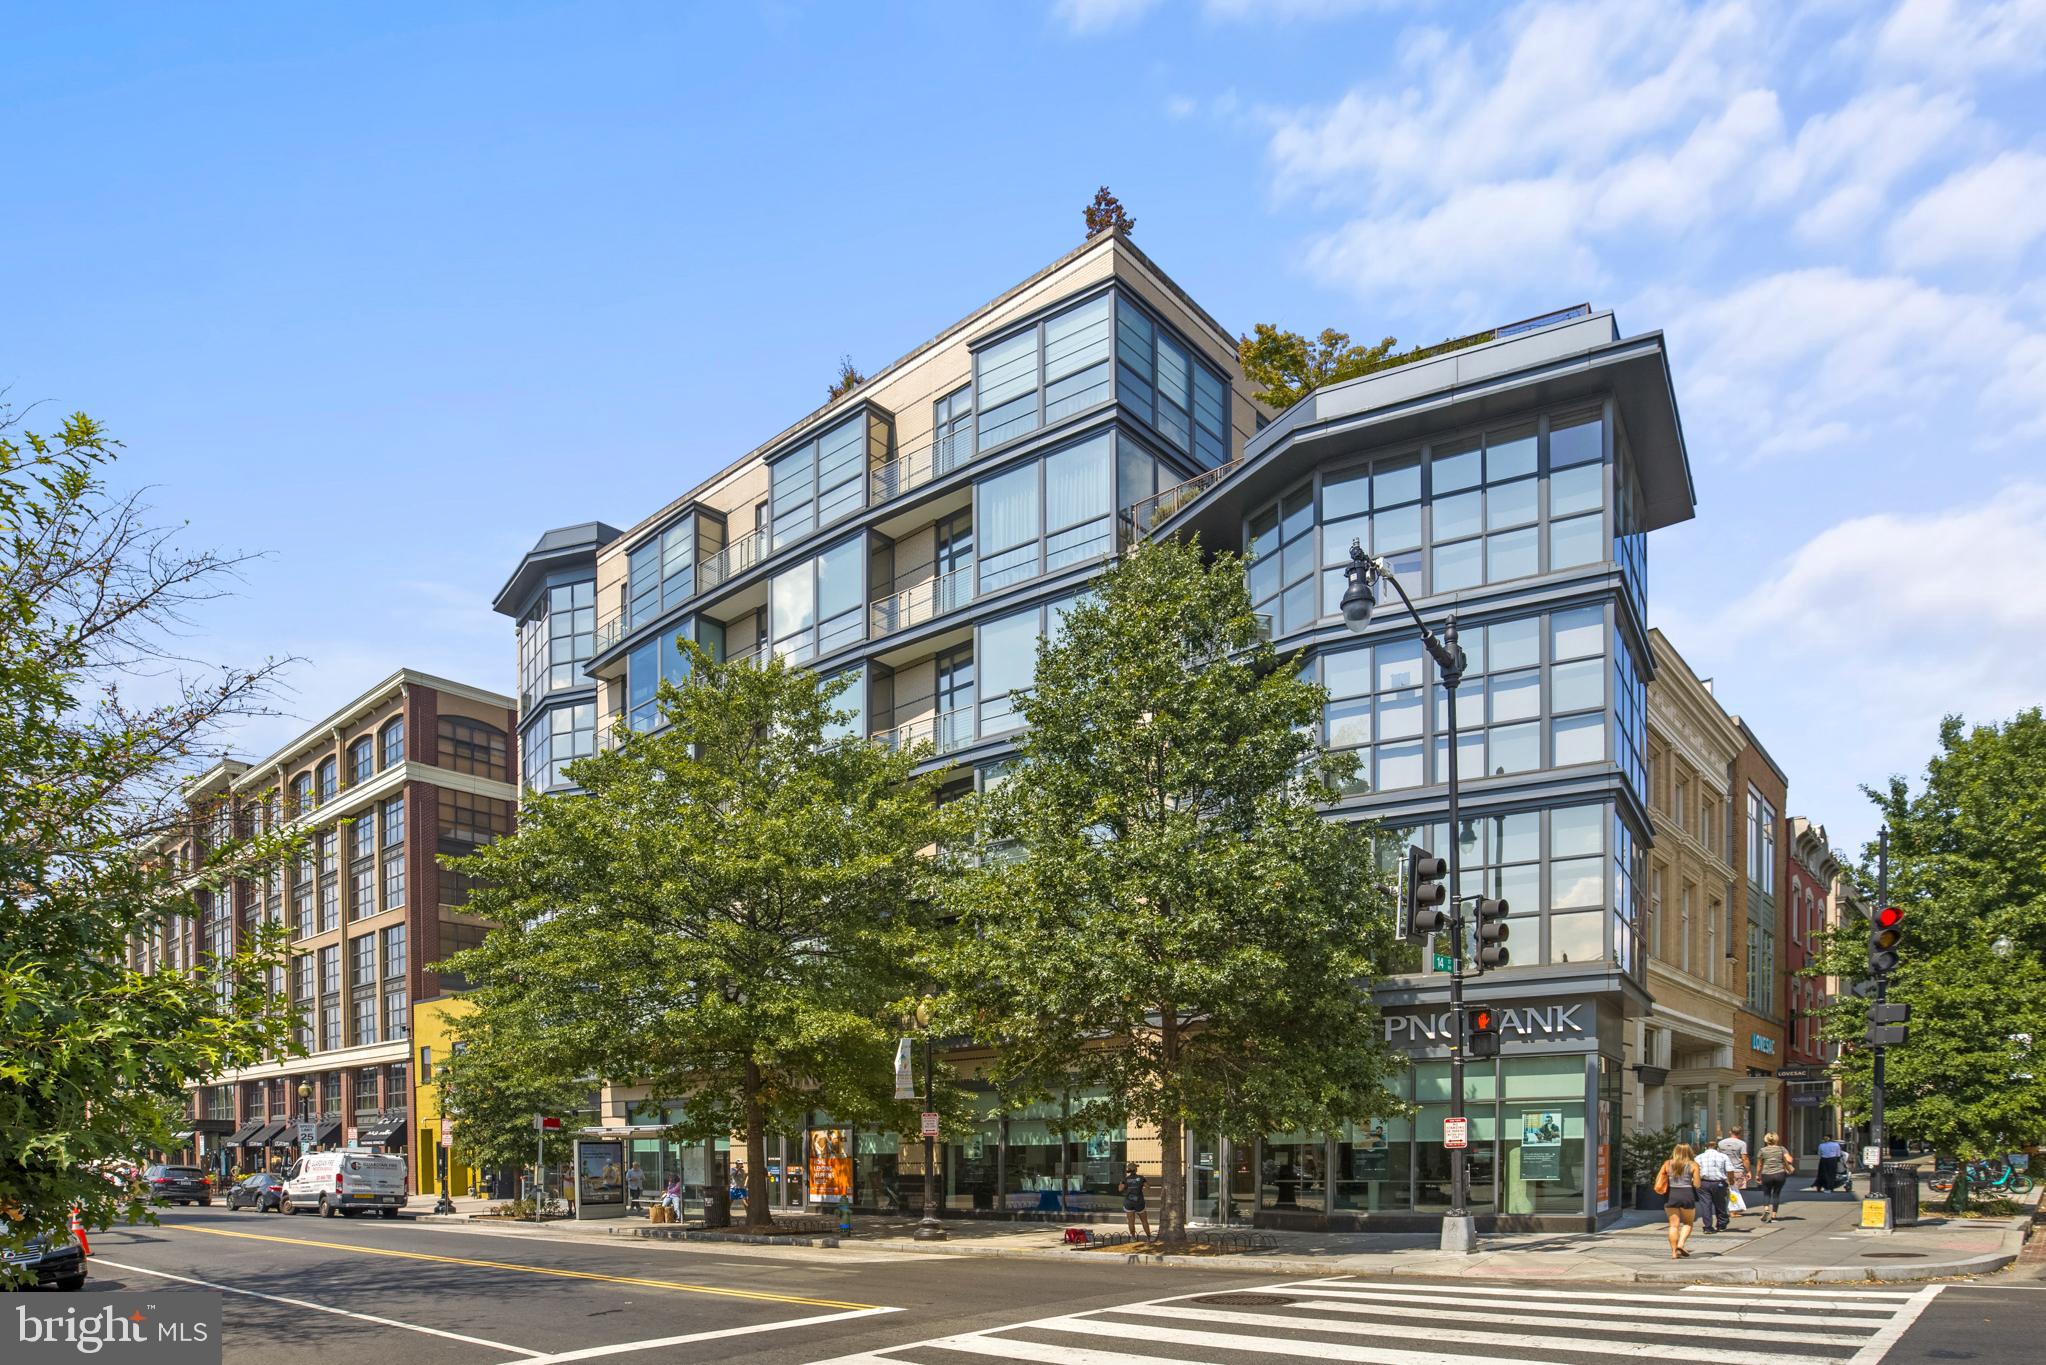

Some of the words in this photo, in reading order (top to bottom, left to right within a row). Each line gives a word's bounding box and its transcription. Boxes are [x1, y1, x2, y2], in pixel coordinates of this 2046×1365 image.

[1437, 956, 1445, 969] 14
[1500, 1004, 1583, 1035] ANK
[300, 1133, 314, 1141] 25
